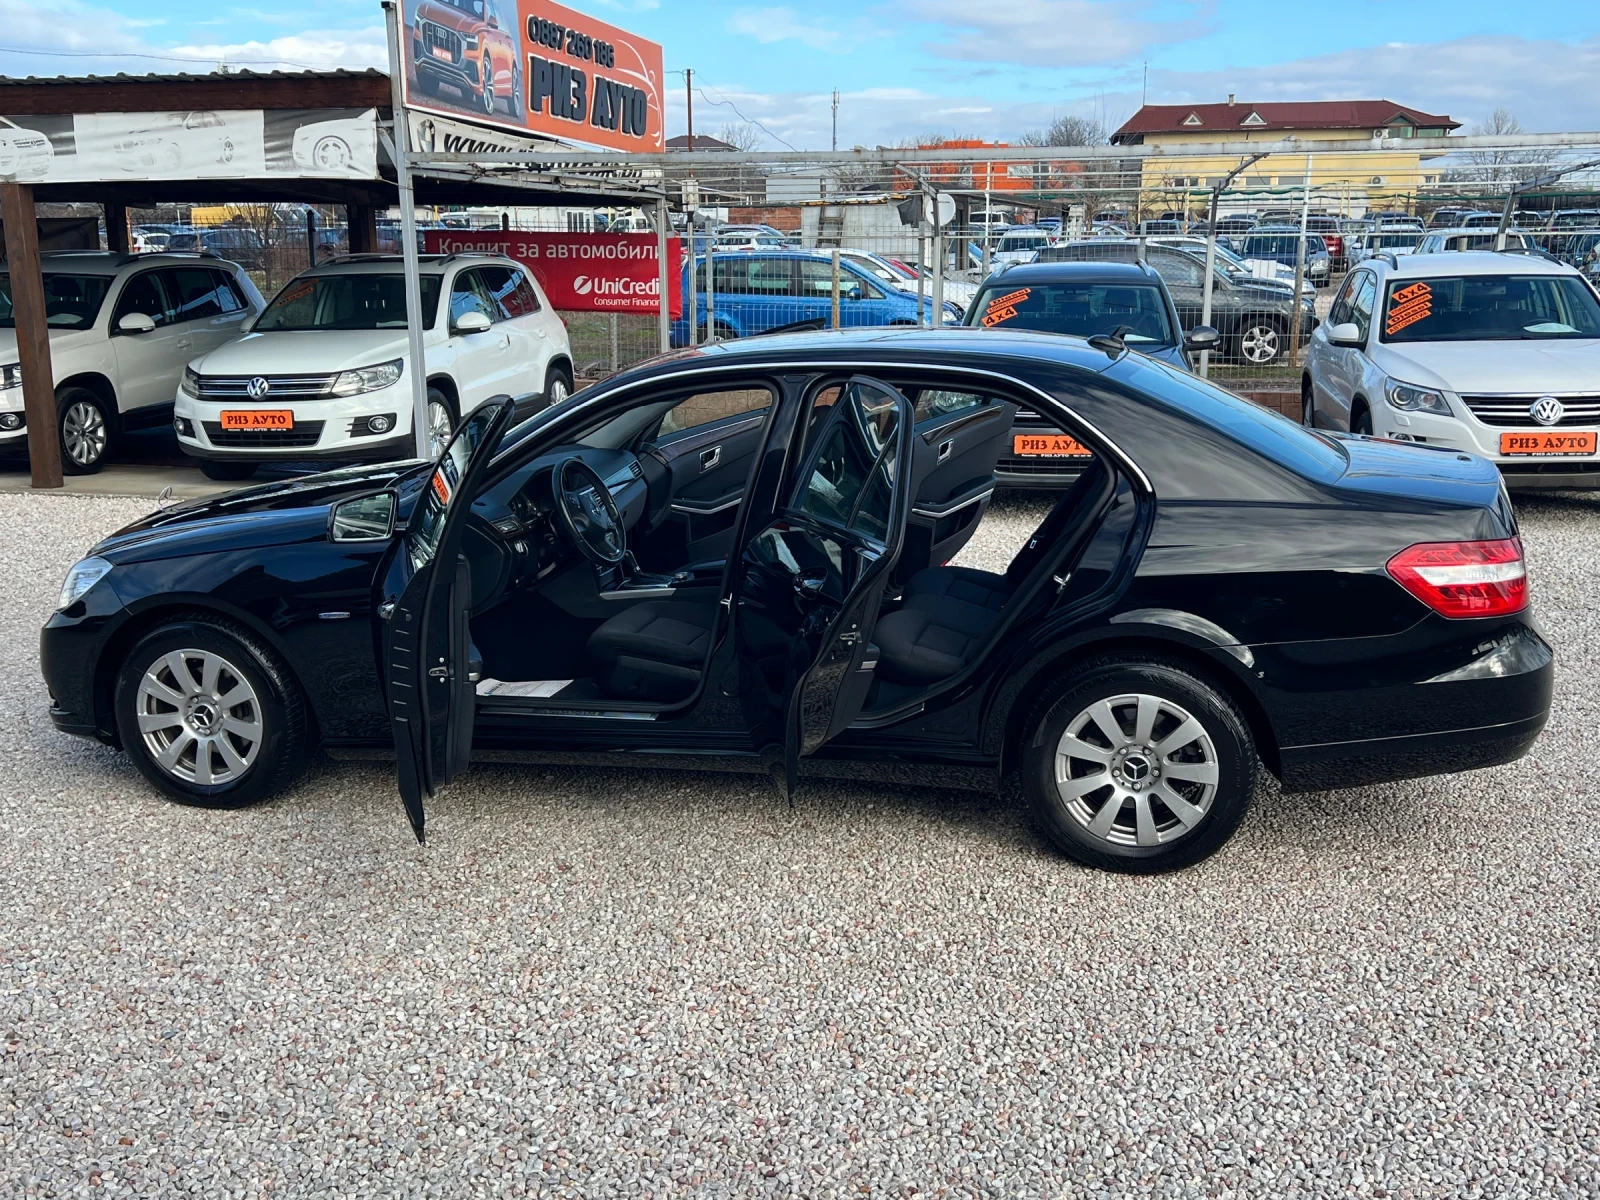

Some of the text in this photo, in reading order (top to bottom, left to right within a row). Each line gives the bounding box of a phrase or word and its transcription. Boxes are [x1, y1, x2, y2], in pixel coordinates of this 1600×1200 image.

[527, 14, 615, 69] 0887 260 186
[528, 53, 648, 138] РИЗ АУТО
[439, 238, 659, 259] Кредит за автомобил
[593, 277, 660, 295] UniCredi
[594, 297, 631, 306] Consumer
[1391, 303, 1429, 322] Diesel
[226, 415, 287, 425] РИЗ АУТО
[1021, 439, 1081, 450] РИЗ АУТ
[1508, 437, 1588, 448] РИЗ АУТО
